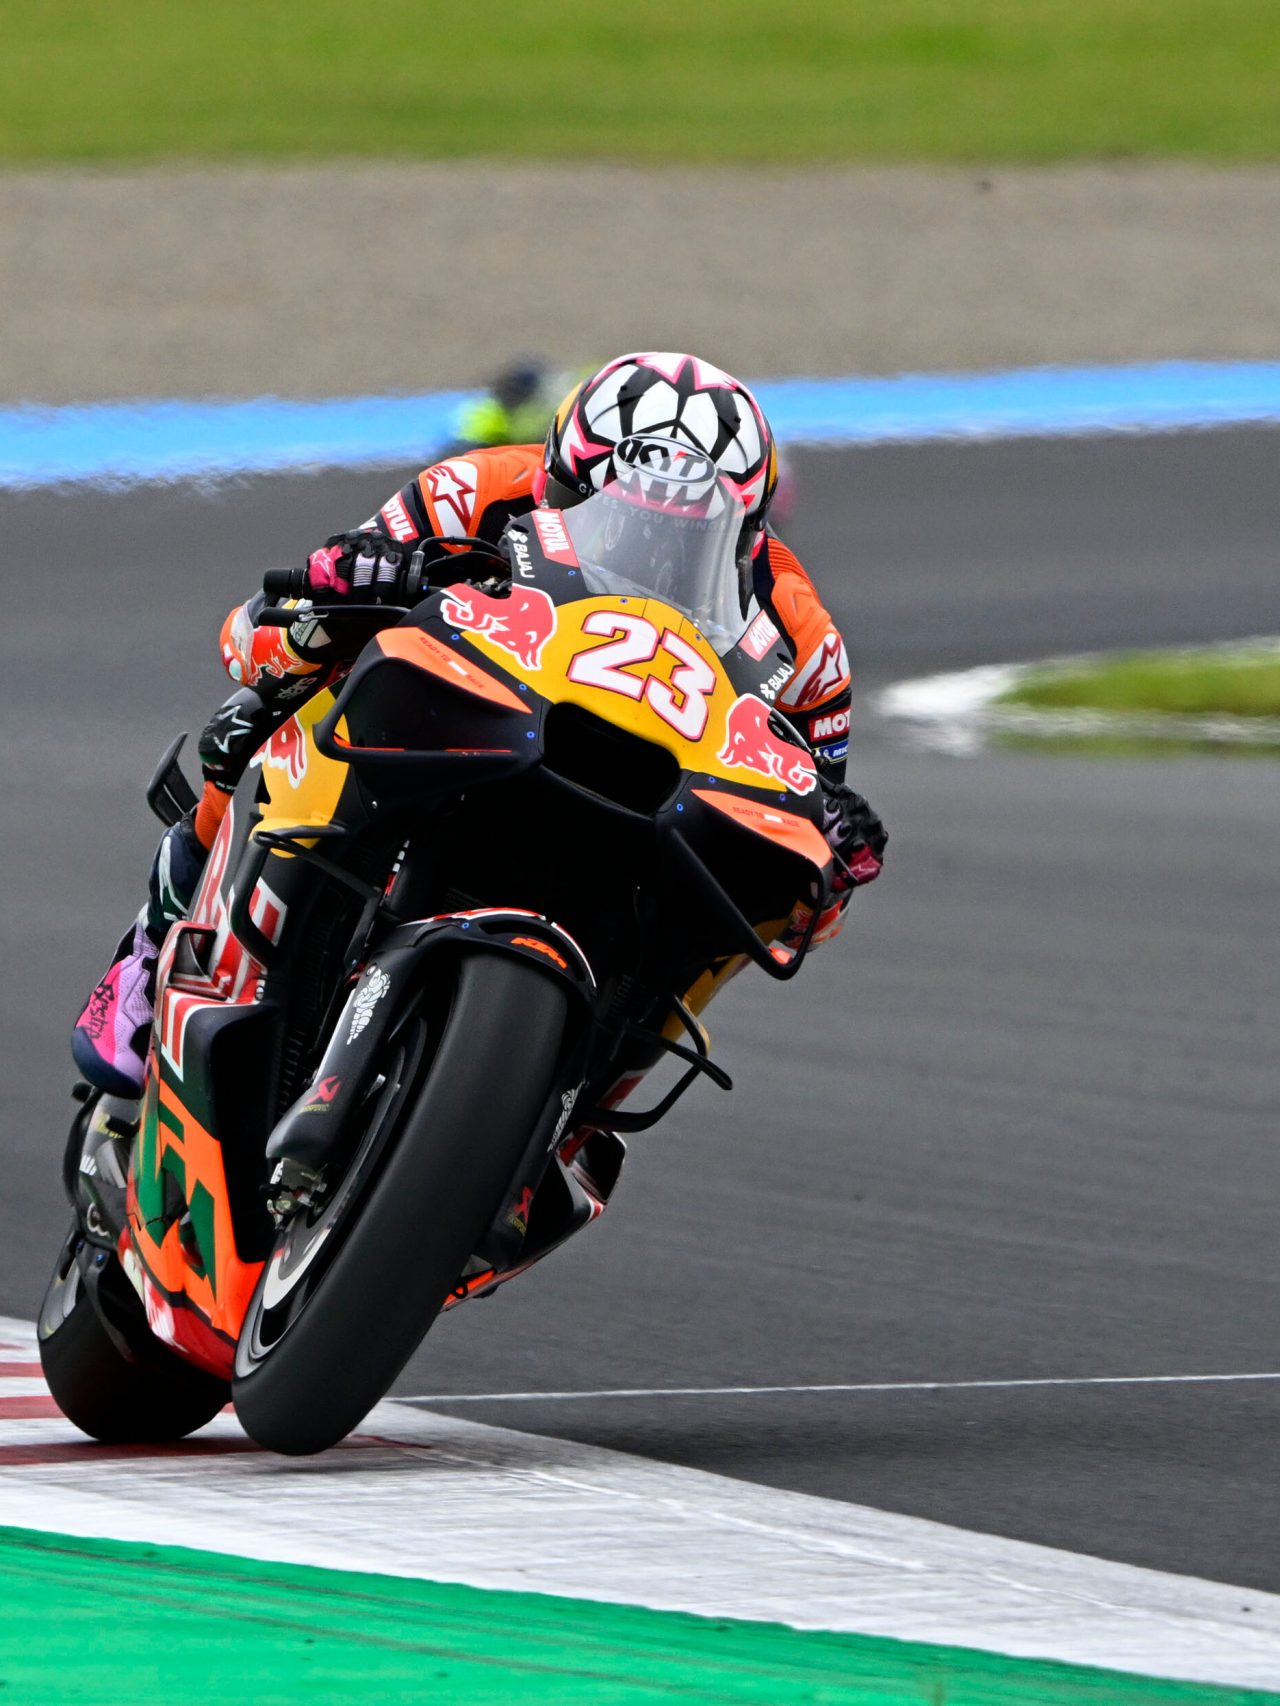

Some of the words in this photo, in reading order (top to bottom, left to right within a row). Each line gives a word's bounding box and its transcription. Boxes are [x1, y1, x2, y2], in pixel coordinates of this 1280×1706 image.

[383, 494, 414, 542] OTUL
[534, 510, 570, 553] MOTUL
[630, 504, 664, 525] YOU
[513, 542, 535, 578] BAJAJ
[566, 610, 717, 742] 23
[768, 662, 794, 691] BAJAJ
